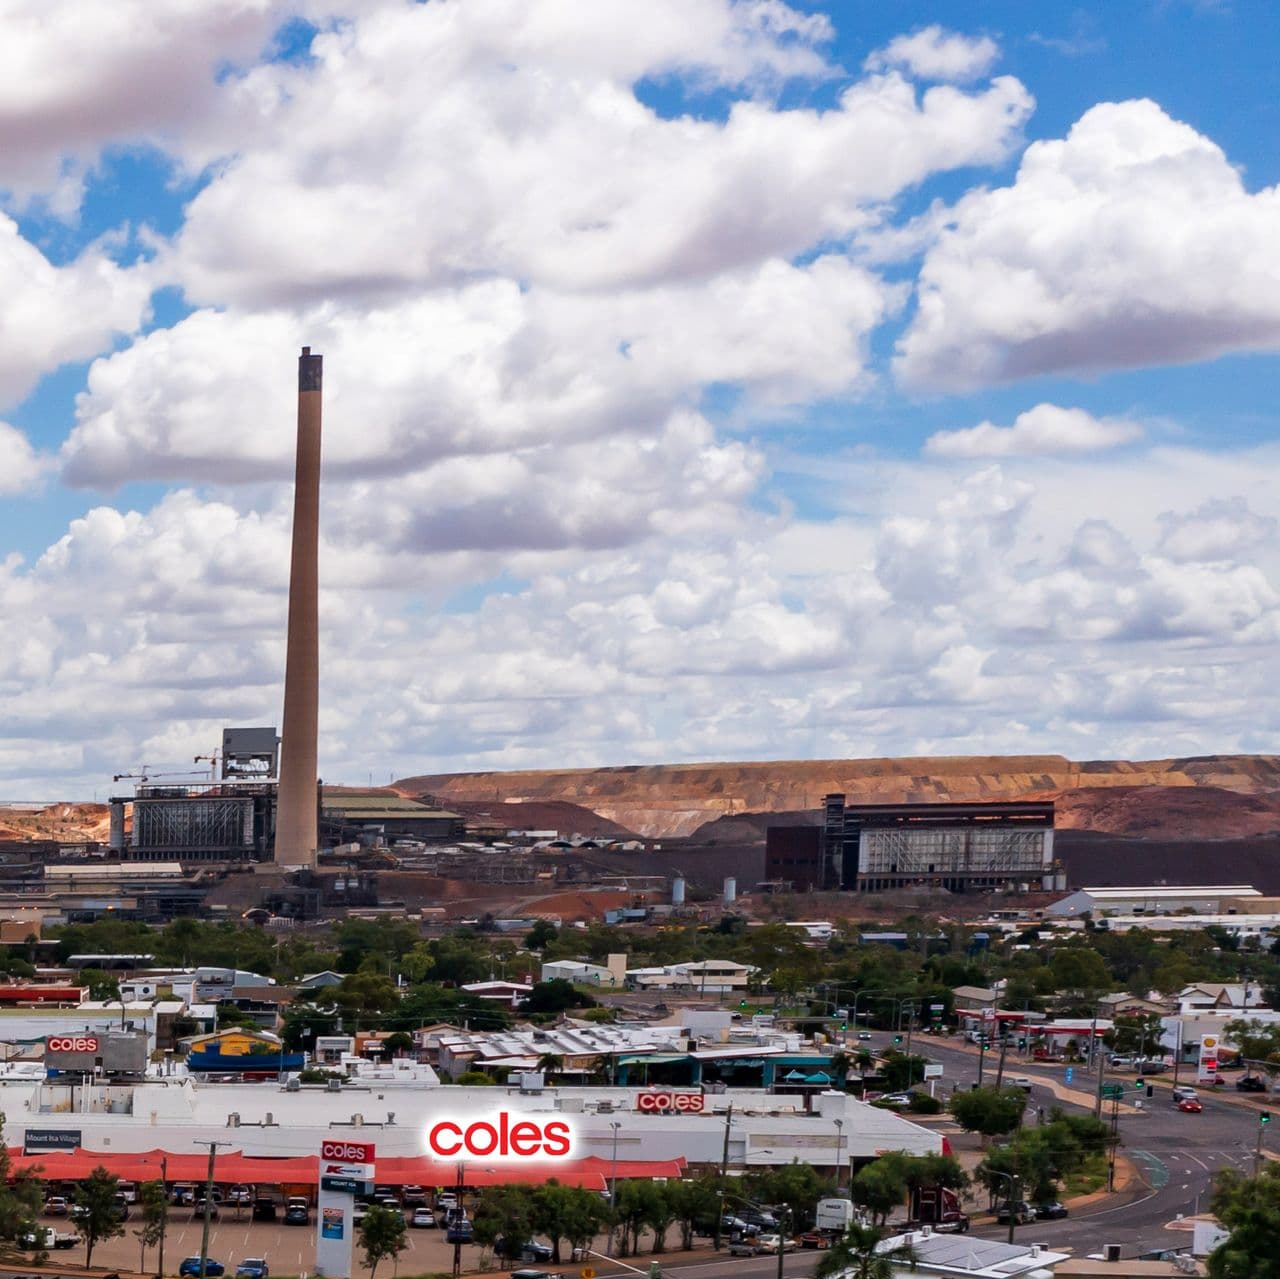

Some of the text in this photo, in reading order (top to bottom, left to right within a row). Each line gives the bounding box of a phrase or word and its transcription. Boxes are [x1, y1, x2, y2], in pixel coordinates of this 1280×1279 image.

[49, 1038, 97, 1051] coles
[640, 1093, 702, 1111] coles
[26, 1134, 48, 1142] Mount
[323, 1143, 366, 1160] coles
